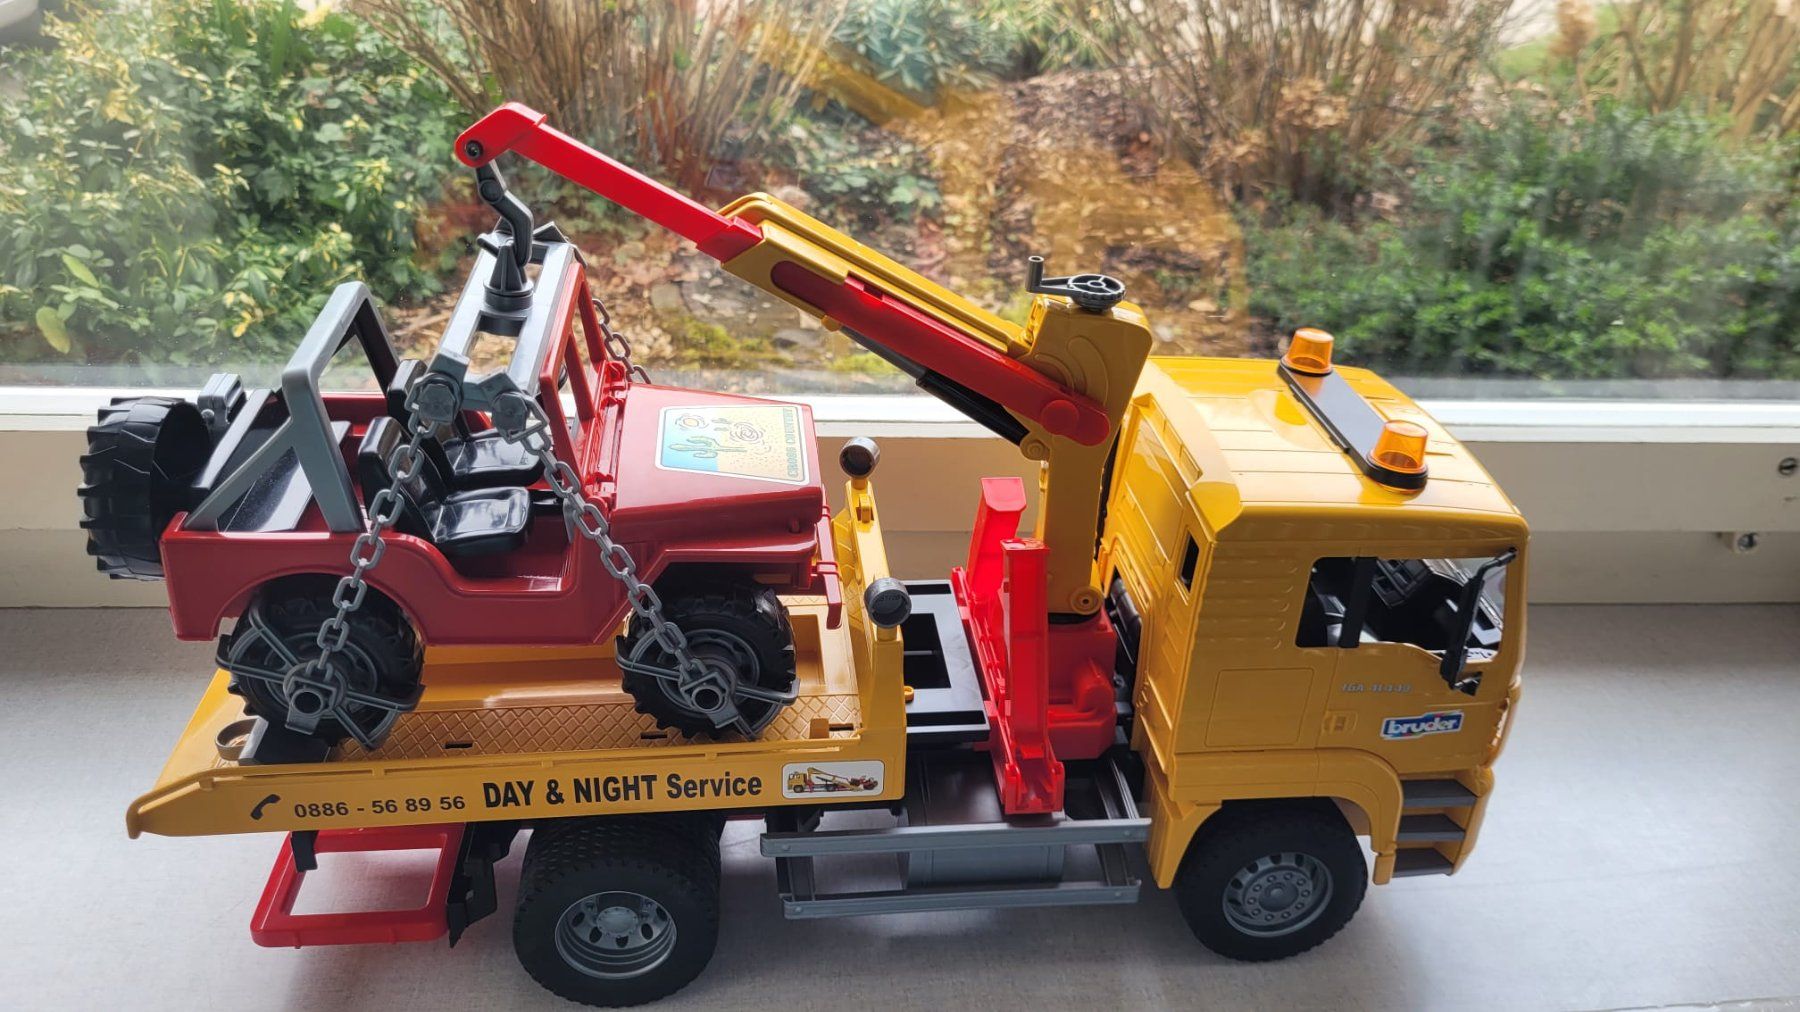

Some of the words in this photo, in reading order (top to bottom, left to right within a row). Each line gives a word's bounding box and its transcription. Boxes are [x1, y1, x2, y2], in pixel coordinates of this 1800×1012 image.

[1387, 717, 1458, 734] bruder
[294, 801, 350, 818] 0886
[371, 799, 398, 815] 56
[405, 797, 432, 812] 89
[439, 795, 466, 810] 56
[482, 779, 535, 808] DAY
[545, 779, 565, 806] &
[573, 774, 658, 804] NIGHT
[666, 771, 763, 799] Service
